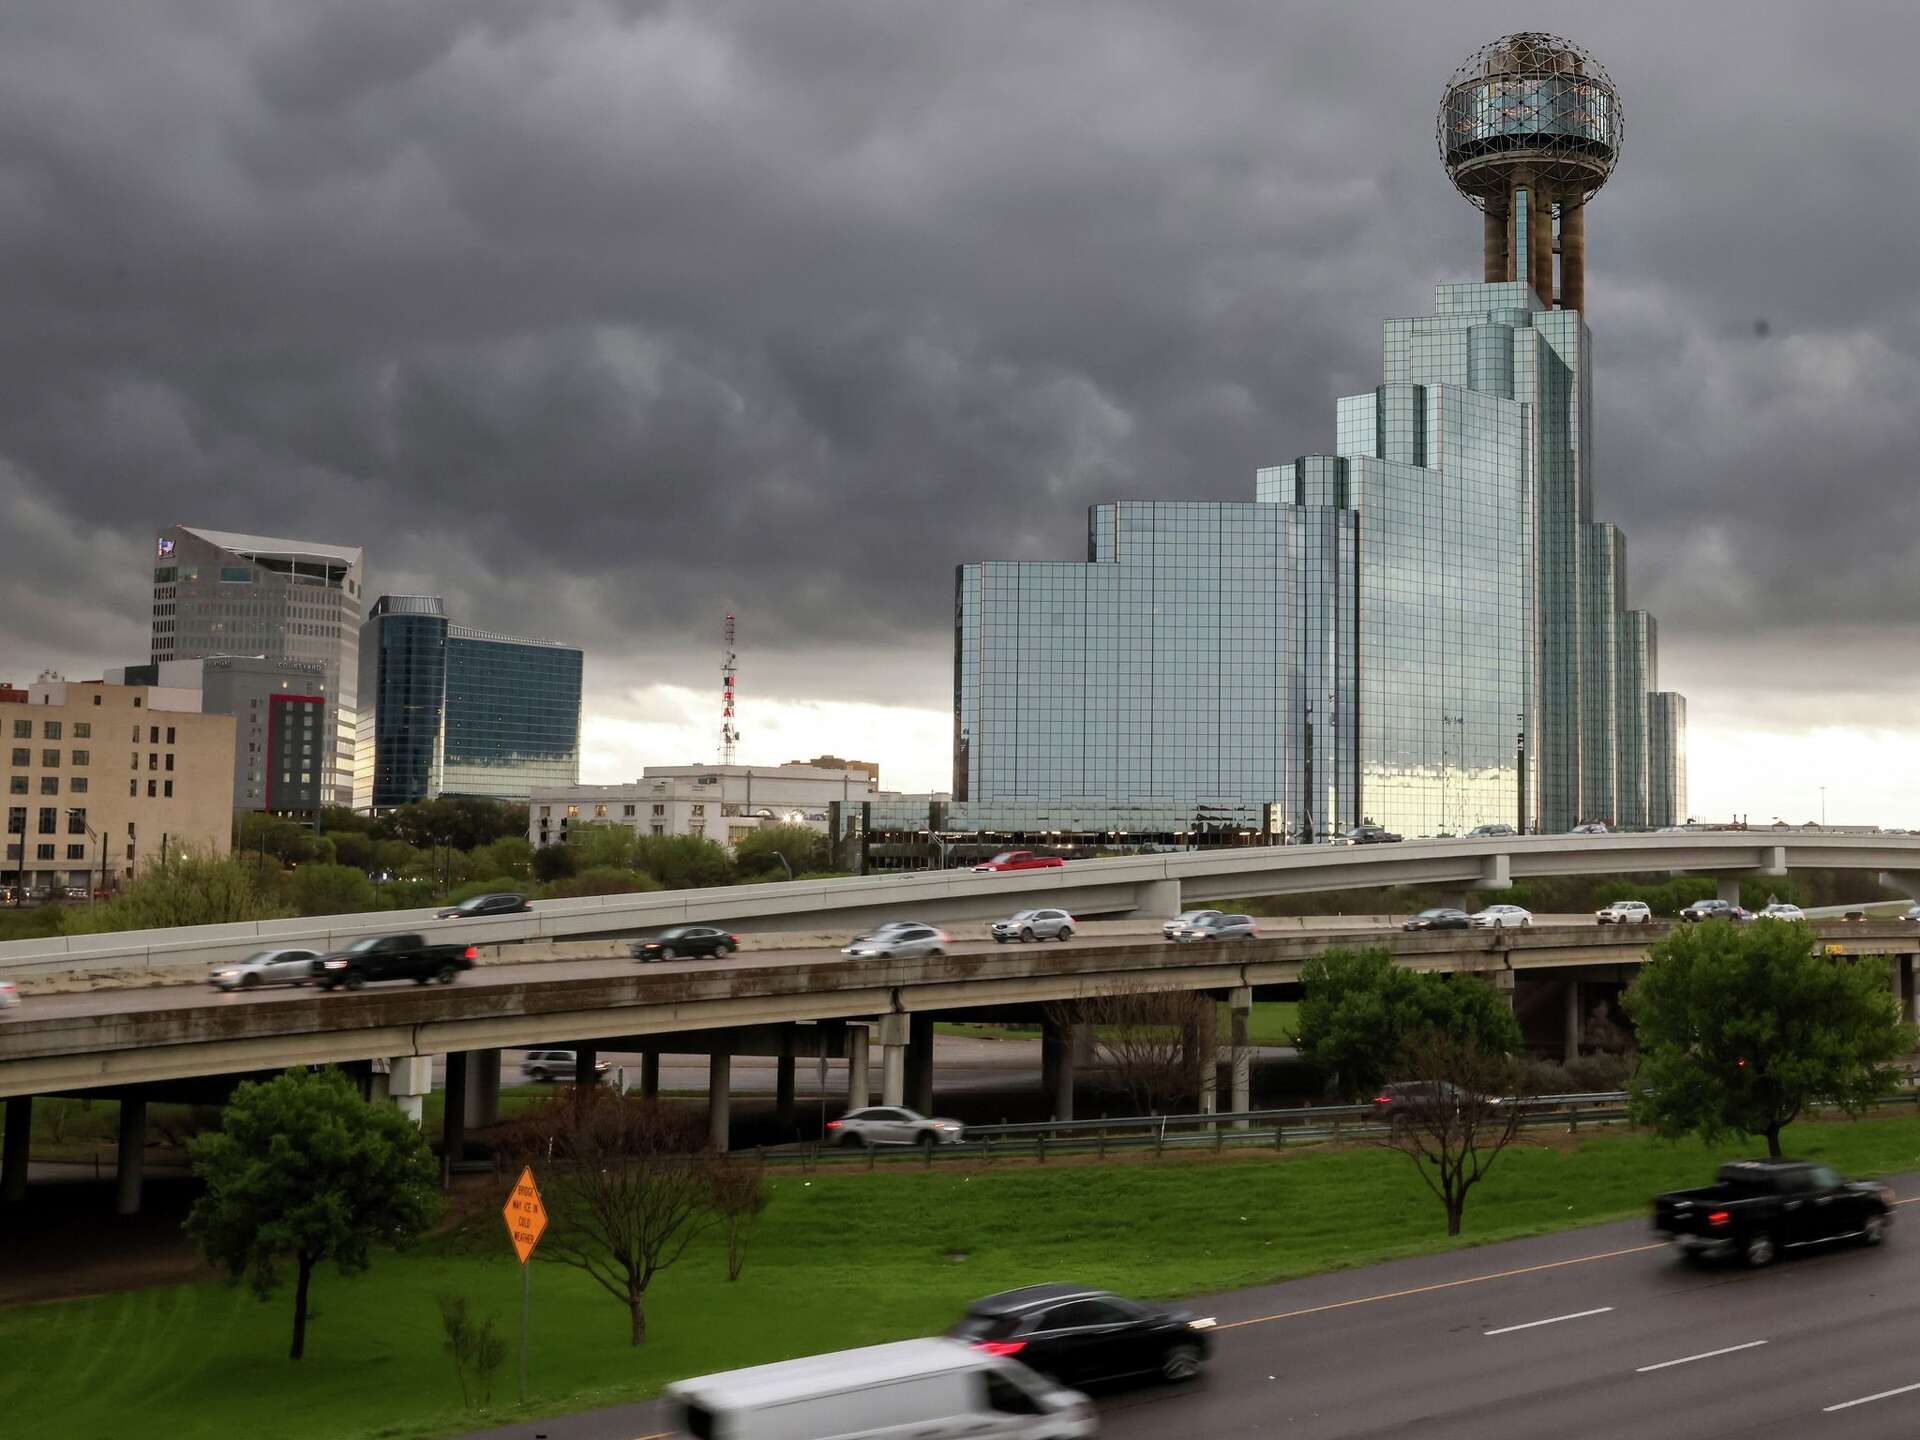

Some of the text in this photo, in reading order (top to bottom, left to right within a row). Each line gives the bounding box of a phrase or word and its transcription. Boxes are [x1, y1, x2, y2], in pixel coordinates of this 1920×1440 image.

[512, 1199, 521, 1209] MAY
[518, 1216, 530, 1228] COLD
[514, 1231, 534, 1245] WEATHER
